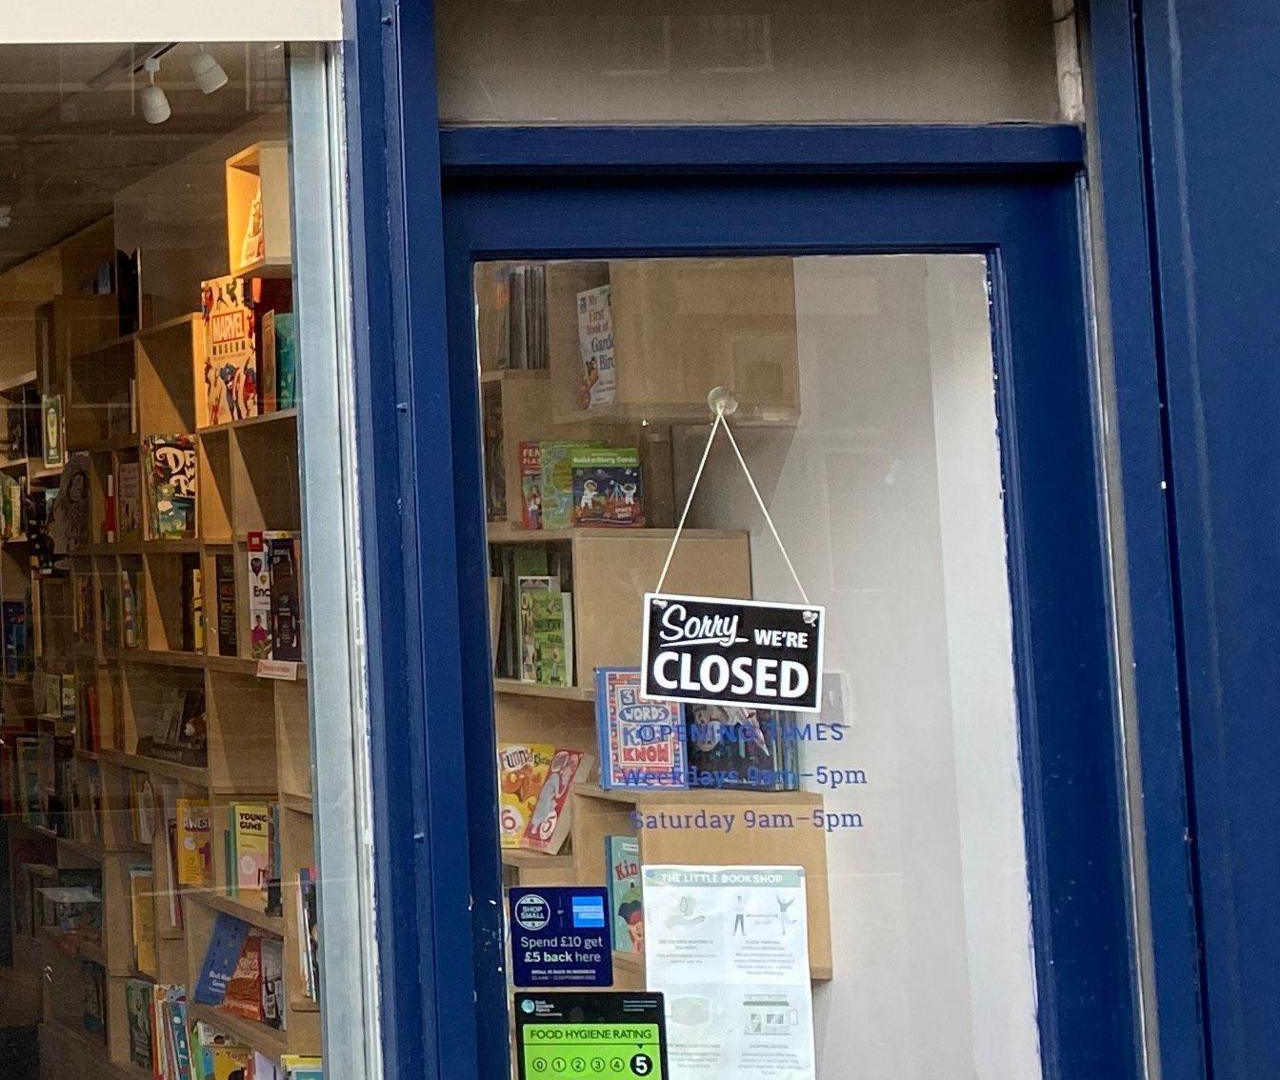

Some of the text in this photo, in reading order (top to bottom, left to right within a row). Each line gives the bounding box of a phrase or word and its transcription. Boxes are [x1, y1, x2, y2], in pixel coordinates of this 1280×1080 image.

[213, 312, 243, 343] MARVEL
[212, 339, 246, 356] MUSEUM
[659, 604, 810, 650] Sorry WE'RE
[652, 650, 811, 698] CLOSED
[622, 705, 667, 722] WORDS
[640, 723, 759, 743] OPENING
[767, 722, 845, 742] TIMES
[622, 742, 669, 763] KNOW
[239, 812, 268, 823] YOUNG
[501, 809, 516, 830] 6
[542, 815, 557, 833] 5
[629, 810, 736, 837] Saturday
[615, 862, 639, 881] Kin
[661, 873, 683, 884] THE
[683, 873, 718, 884] LITTLE
[520, 936, 604, 950] Spend £10 get
[523, 951, 602, 963] £5 back here
[530, 1029, 653, 1039] FOOD HYGIENE RATING
[635, 1056, 648, 1074] 5
